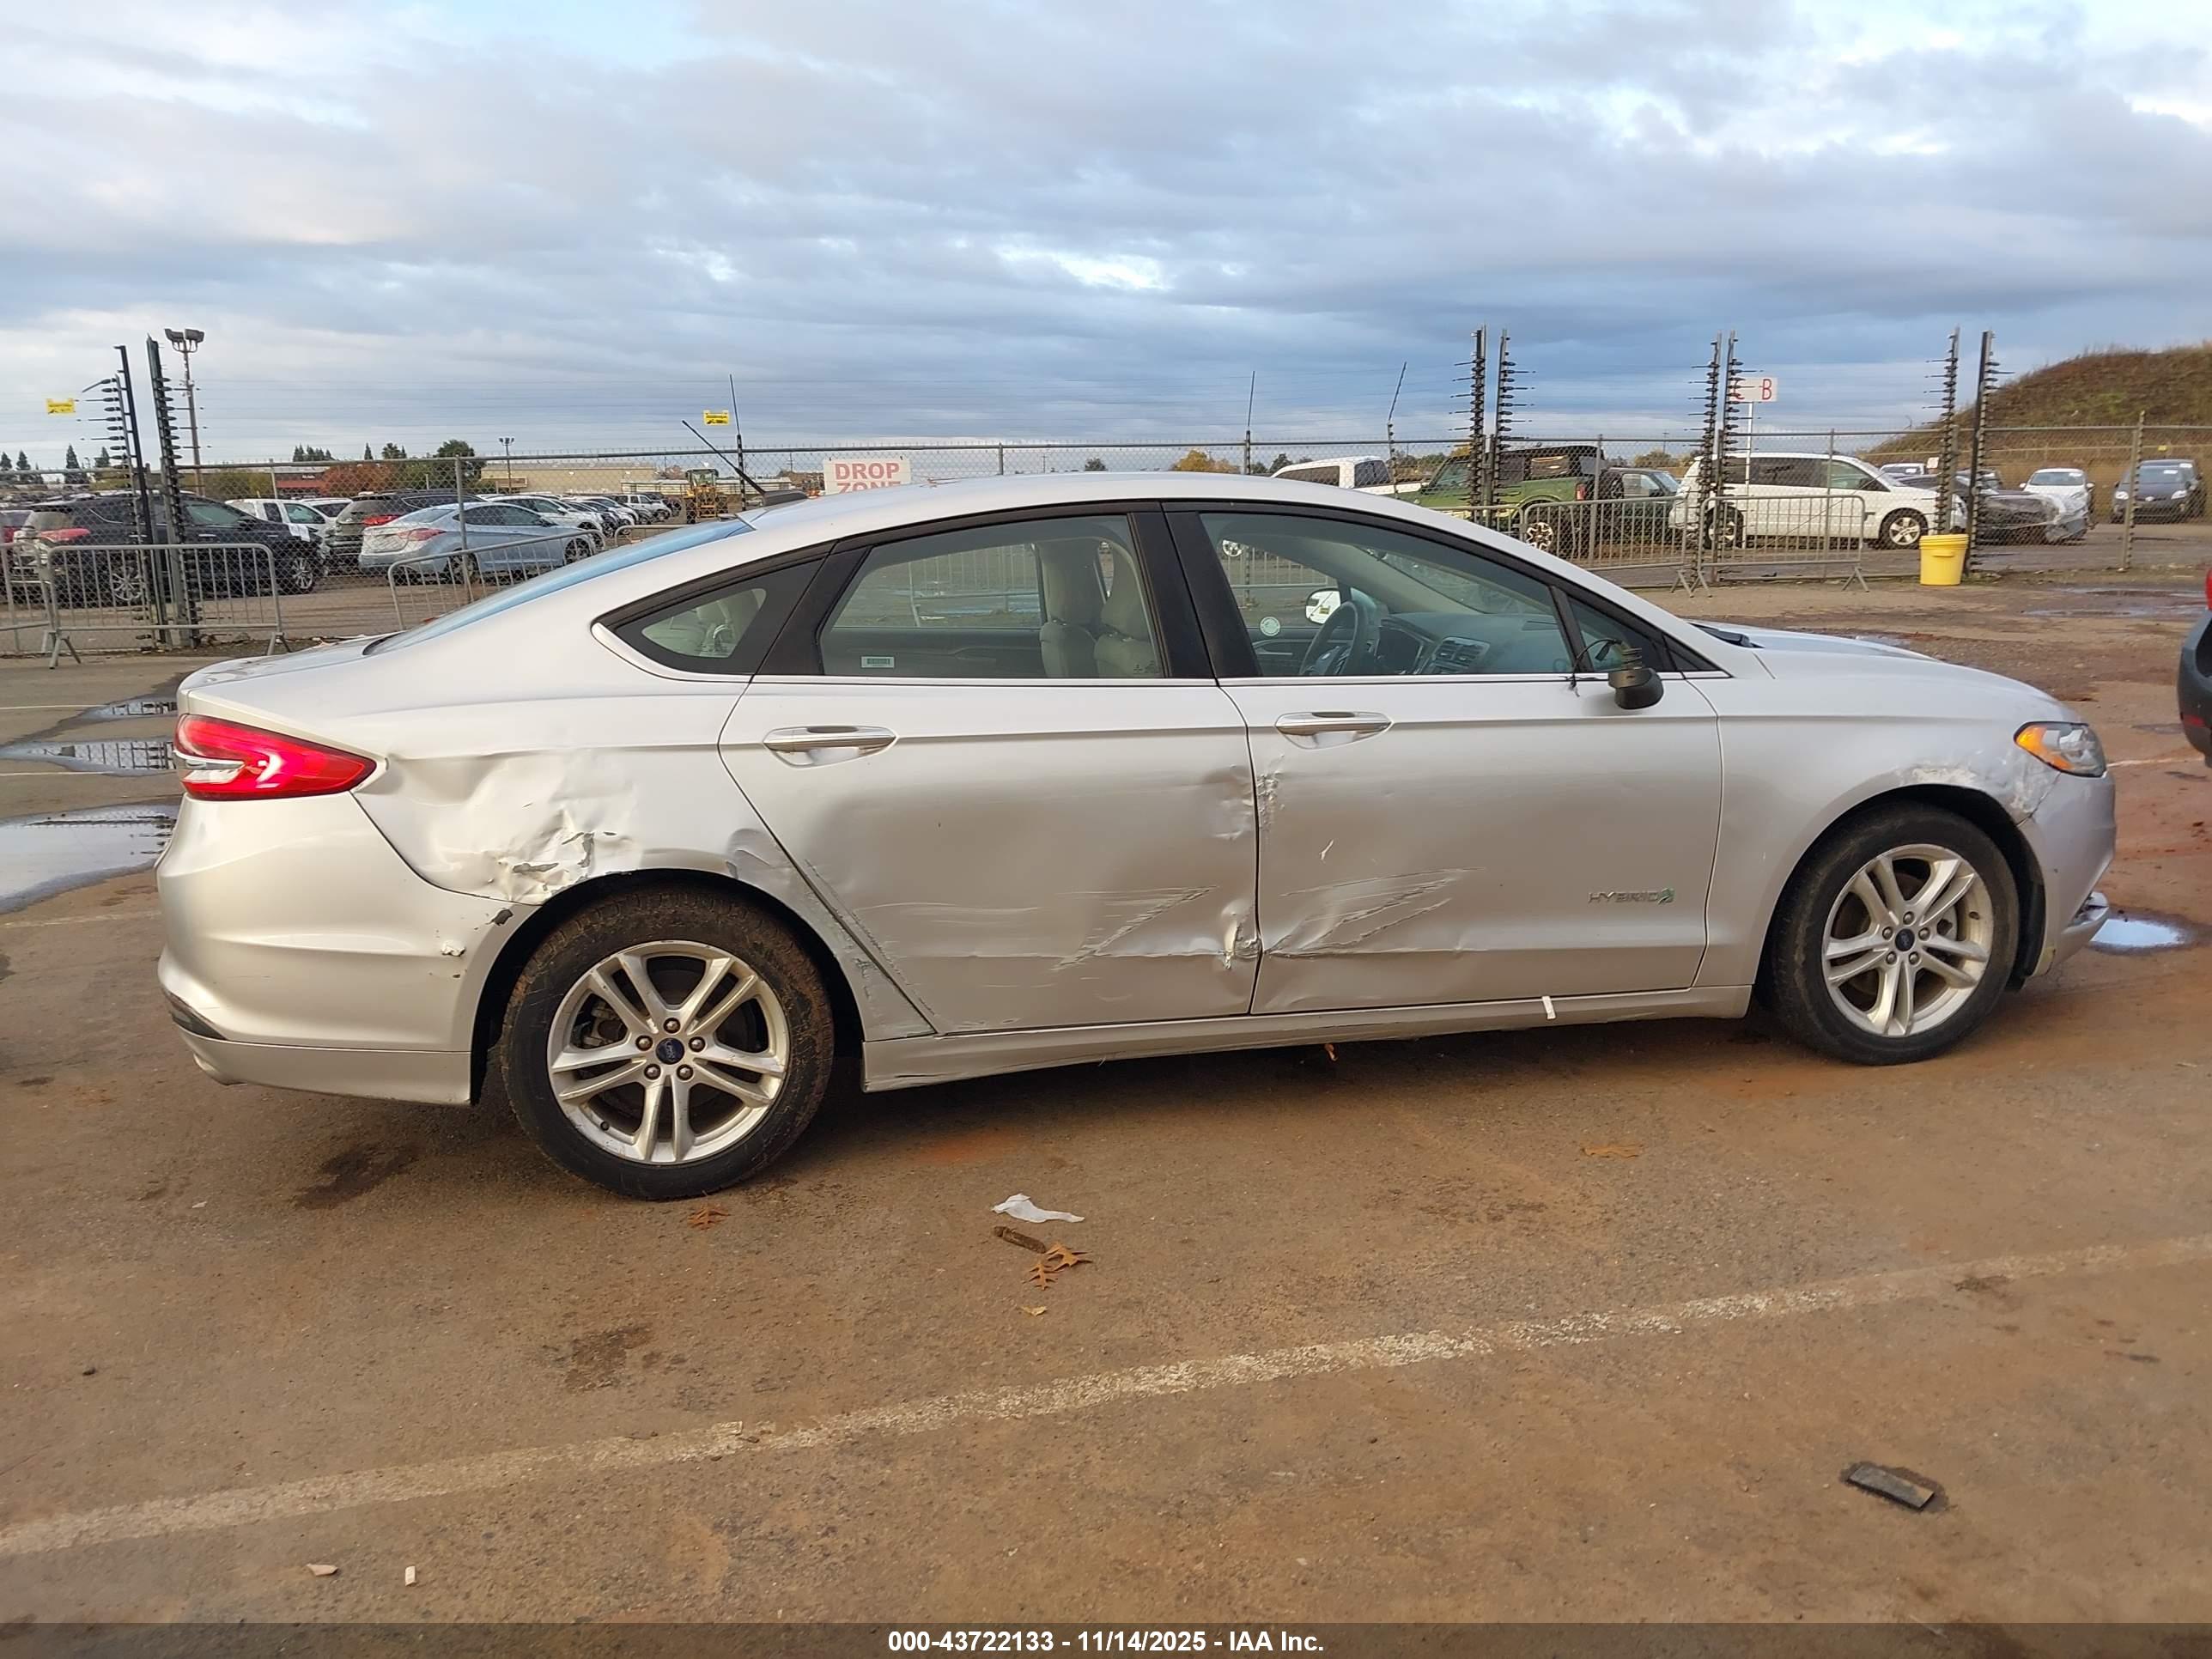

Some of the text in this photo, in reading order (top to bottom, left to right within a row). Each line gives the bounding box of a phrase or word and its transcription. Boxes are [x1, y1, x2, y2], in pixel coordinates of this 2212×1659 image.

[1762, 379, 1772, 399] B
[835, 463, 900, 480] DROP
[1588, 890, 1659, 904] HYBRID
